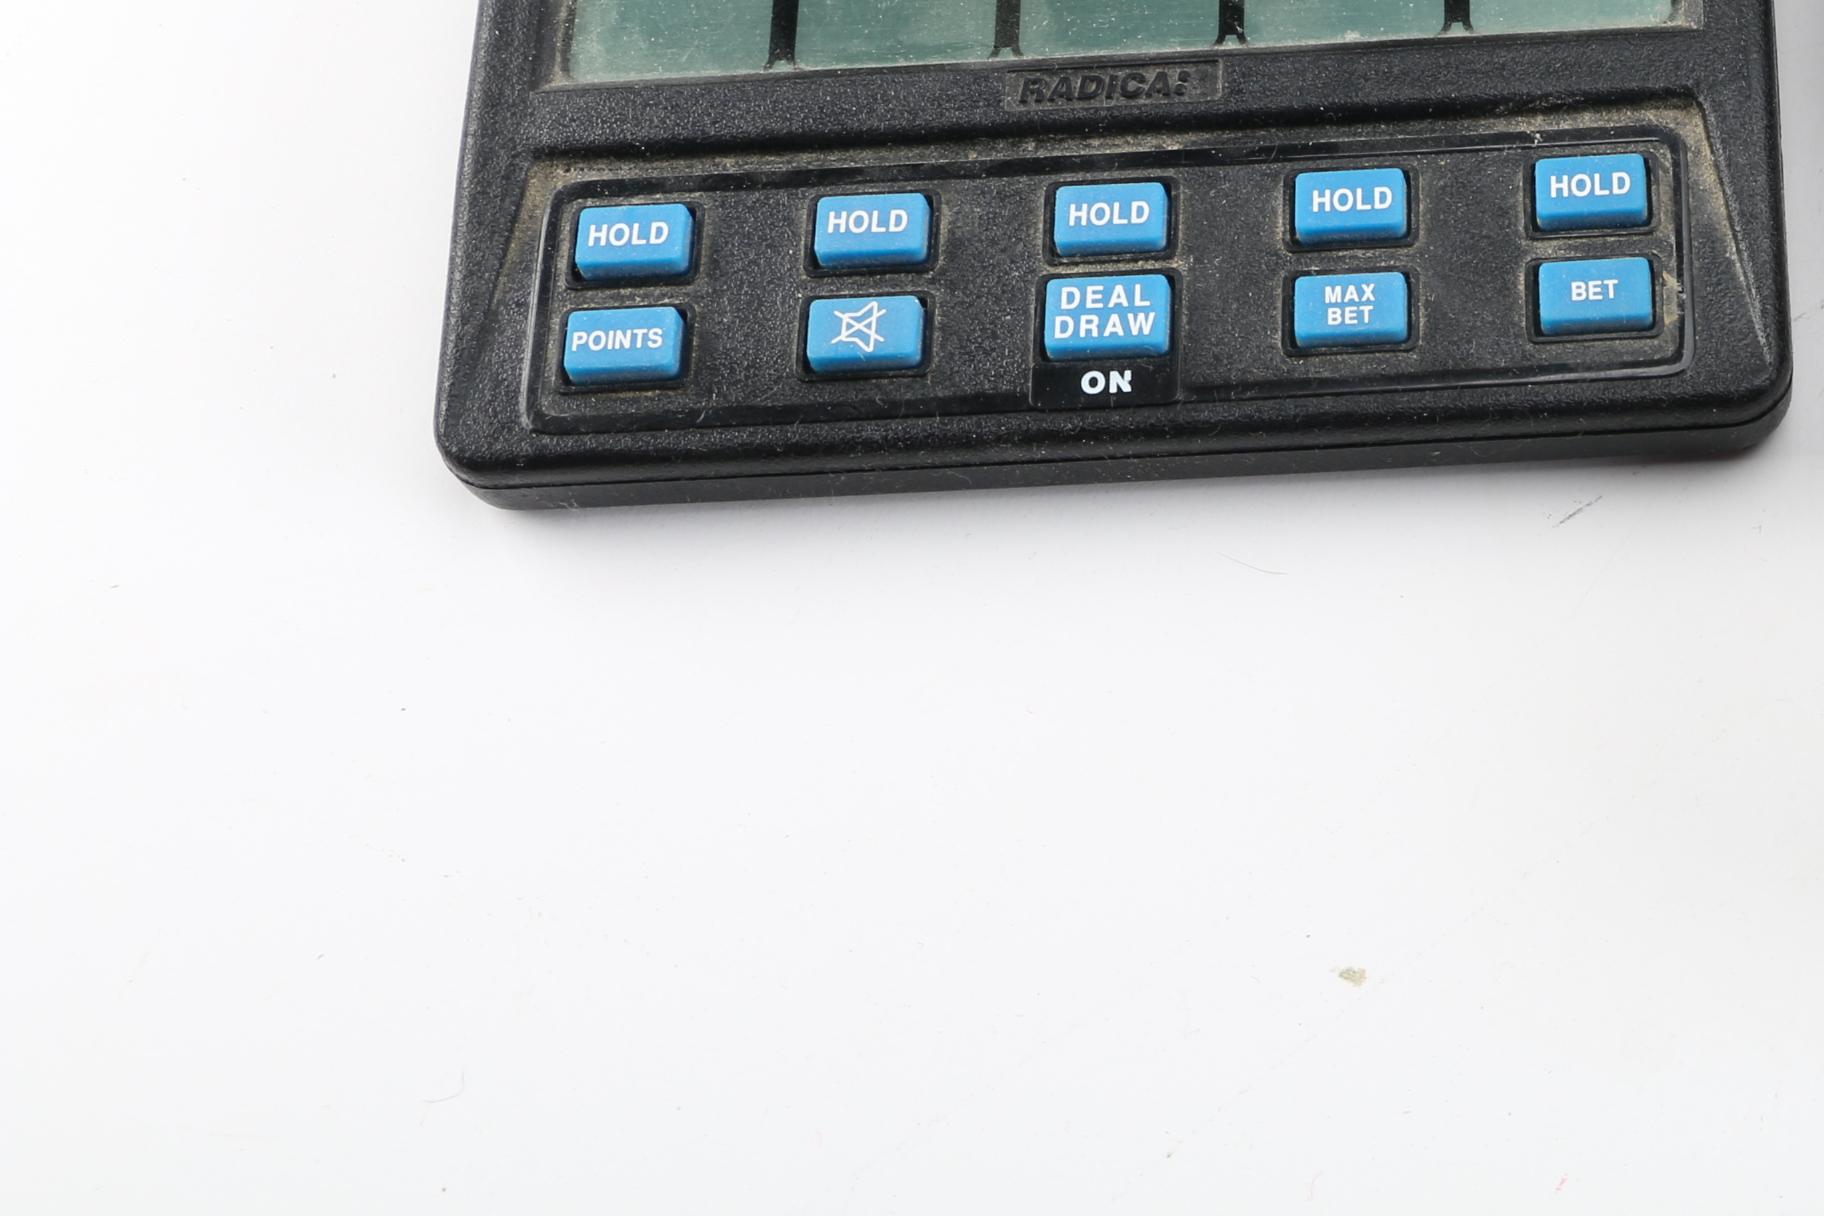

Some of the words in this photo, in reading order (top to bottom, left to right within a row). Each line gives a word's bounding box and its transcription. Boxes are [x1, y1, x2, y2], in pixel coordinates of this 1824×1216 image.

[1550, 172, 1631, 198] HOLD
[1312, 187, 1393, 212] HOLD
[826, 208, 910, 235] HOLD
[1067, 200, 1150, 228] HOLD
[587, 221, 669, 247] HOLD
[1061, 286, 1150, 310] DEAL
[1324, 284, 1376, 304] MAX
[1571, 280, 1619, 302] BET
[1054, 312, 1156, 339] DRAW
[1327, 305, 1373, 326] BET
[572, 326, 664, 352] POINTS
[1080, 369, 1133, 395] ON
